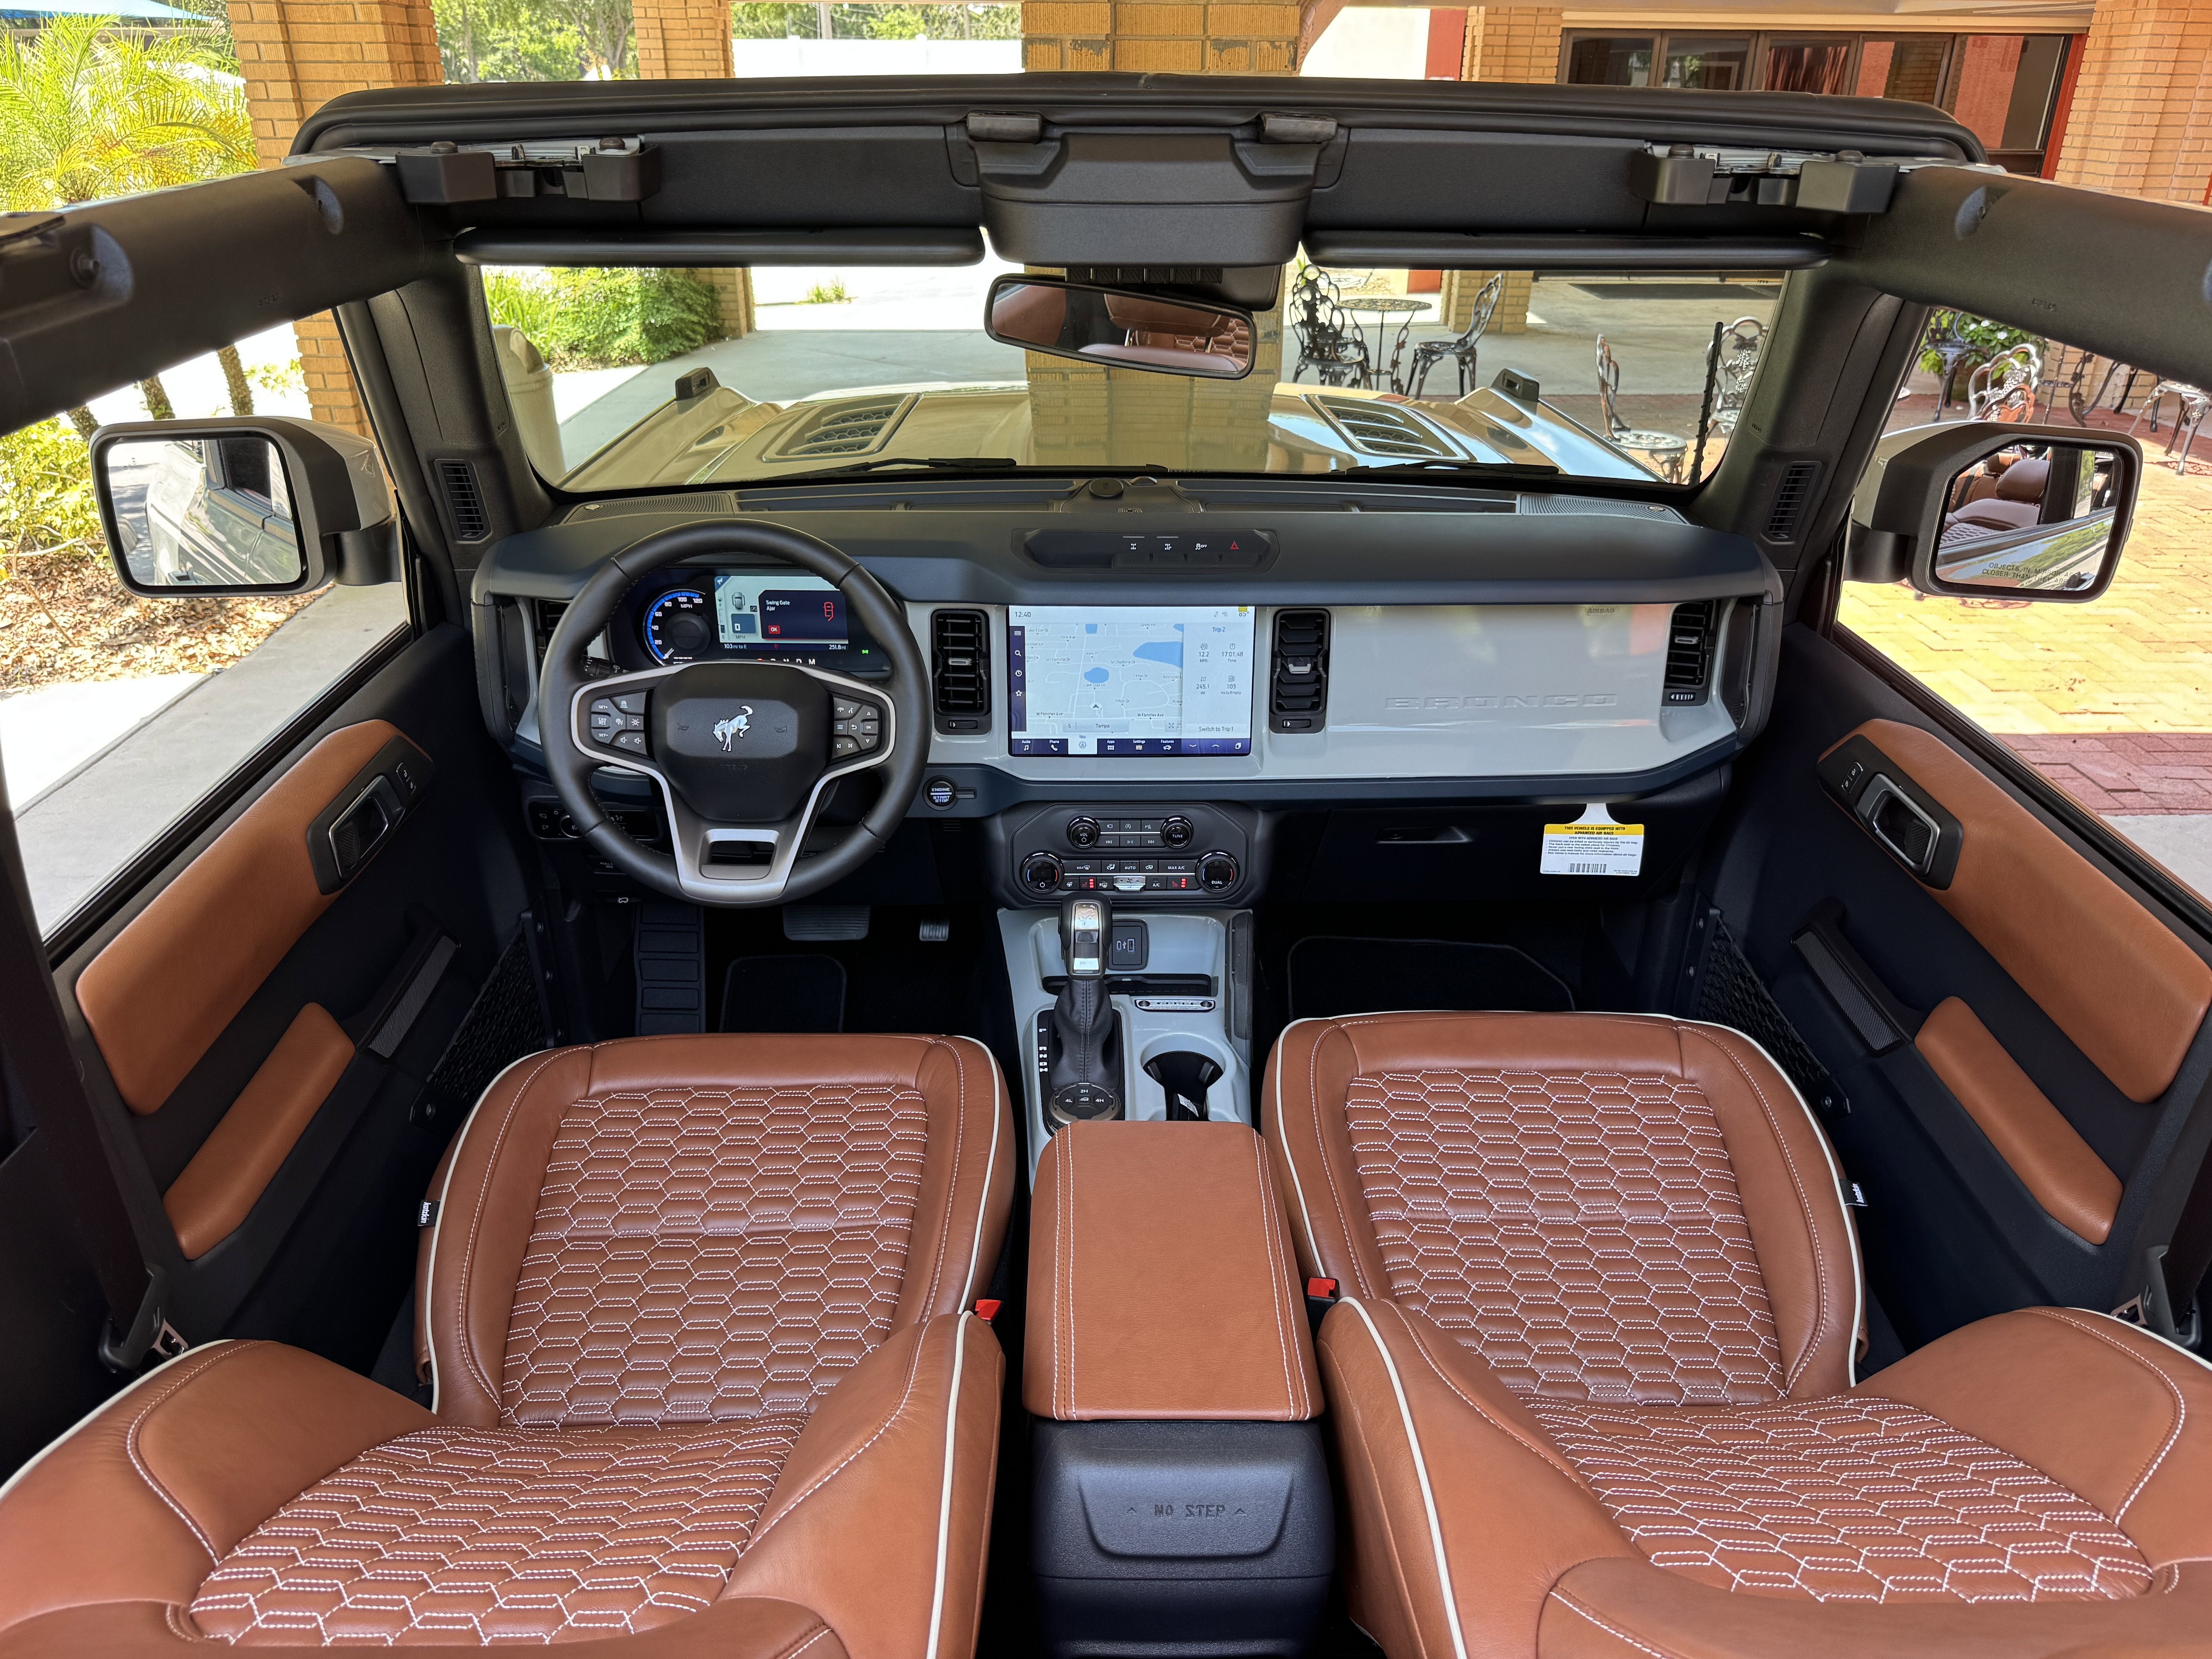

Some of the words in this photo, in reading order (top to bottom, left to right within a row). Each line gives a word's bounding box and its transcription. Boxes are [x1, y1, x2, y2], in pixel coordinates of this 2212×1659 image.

[1982, 568, 2008, 577] CLOSER
[1989, 563, 2020, 572] OBJECTS
[2034, 568, 2061, 577] MIRROR
[1385, 694, 1617, 710] BRONCO
[421, 1202, 431, 1223] katzkin
[1154, 1504, 1174, 1518] NO
[1185, 1505, 1225, 1518] STEP
